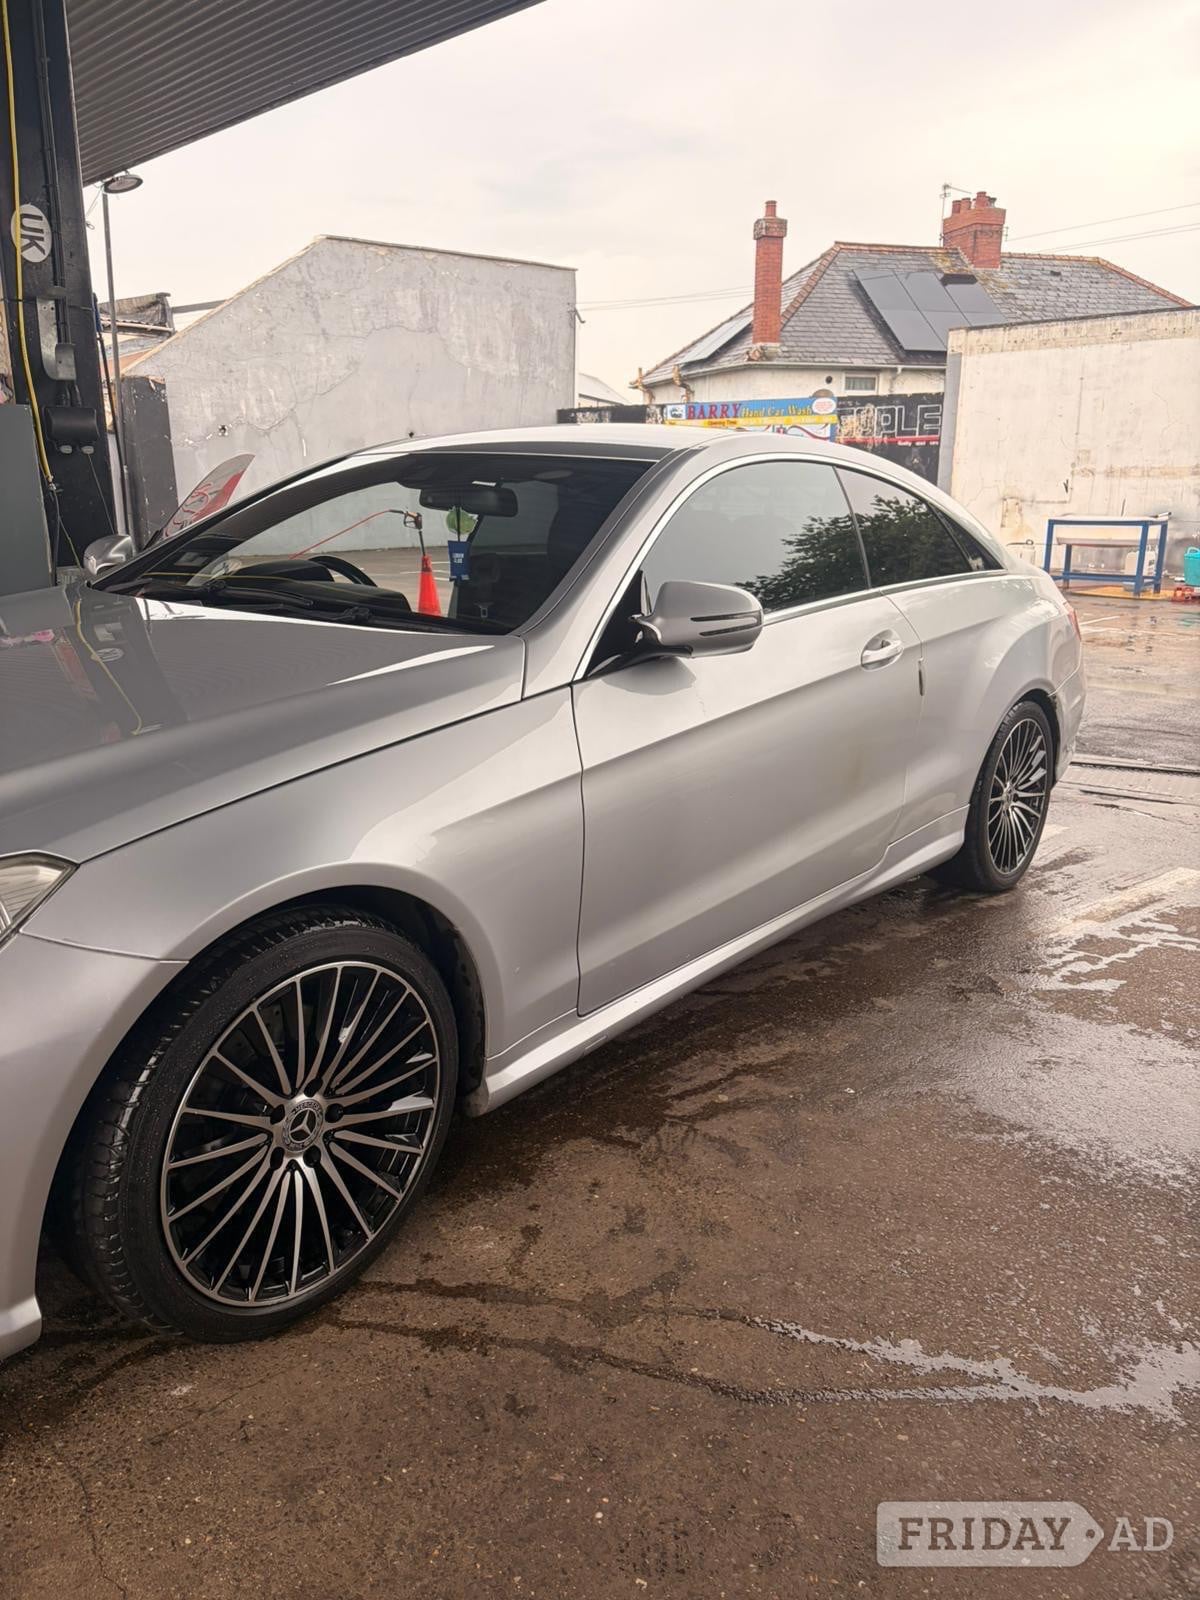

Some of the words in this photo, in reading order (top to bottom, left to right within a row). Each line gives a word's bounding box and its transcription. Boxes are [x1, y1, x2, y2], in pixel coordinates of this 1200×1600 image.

[20, 213, 46, 256] UK
[688, 403, 742, 420] BARRY
[742, 407, 765, 417] Hand
[768, 406, 784, 416] Car
[788, 404, 812, 416] Wash
